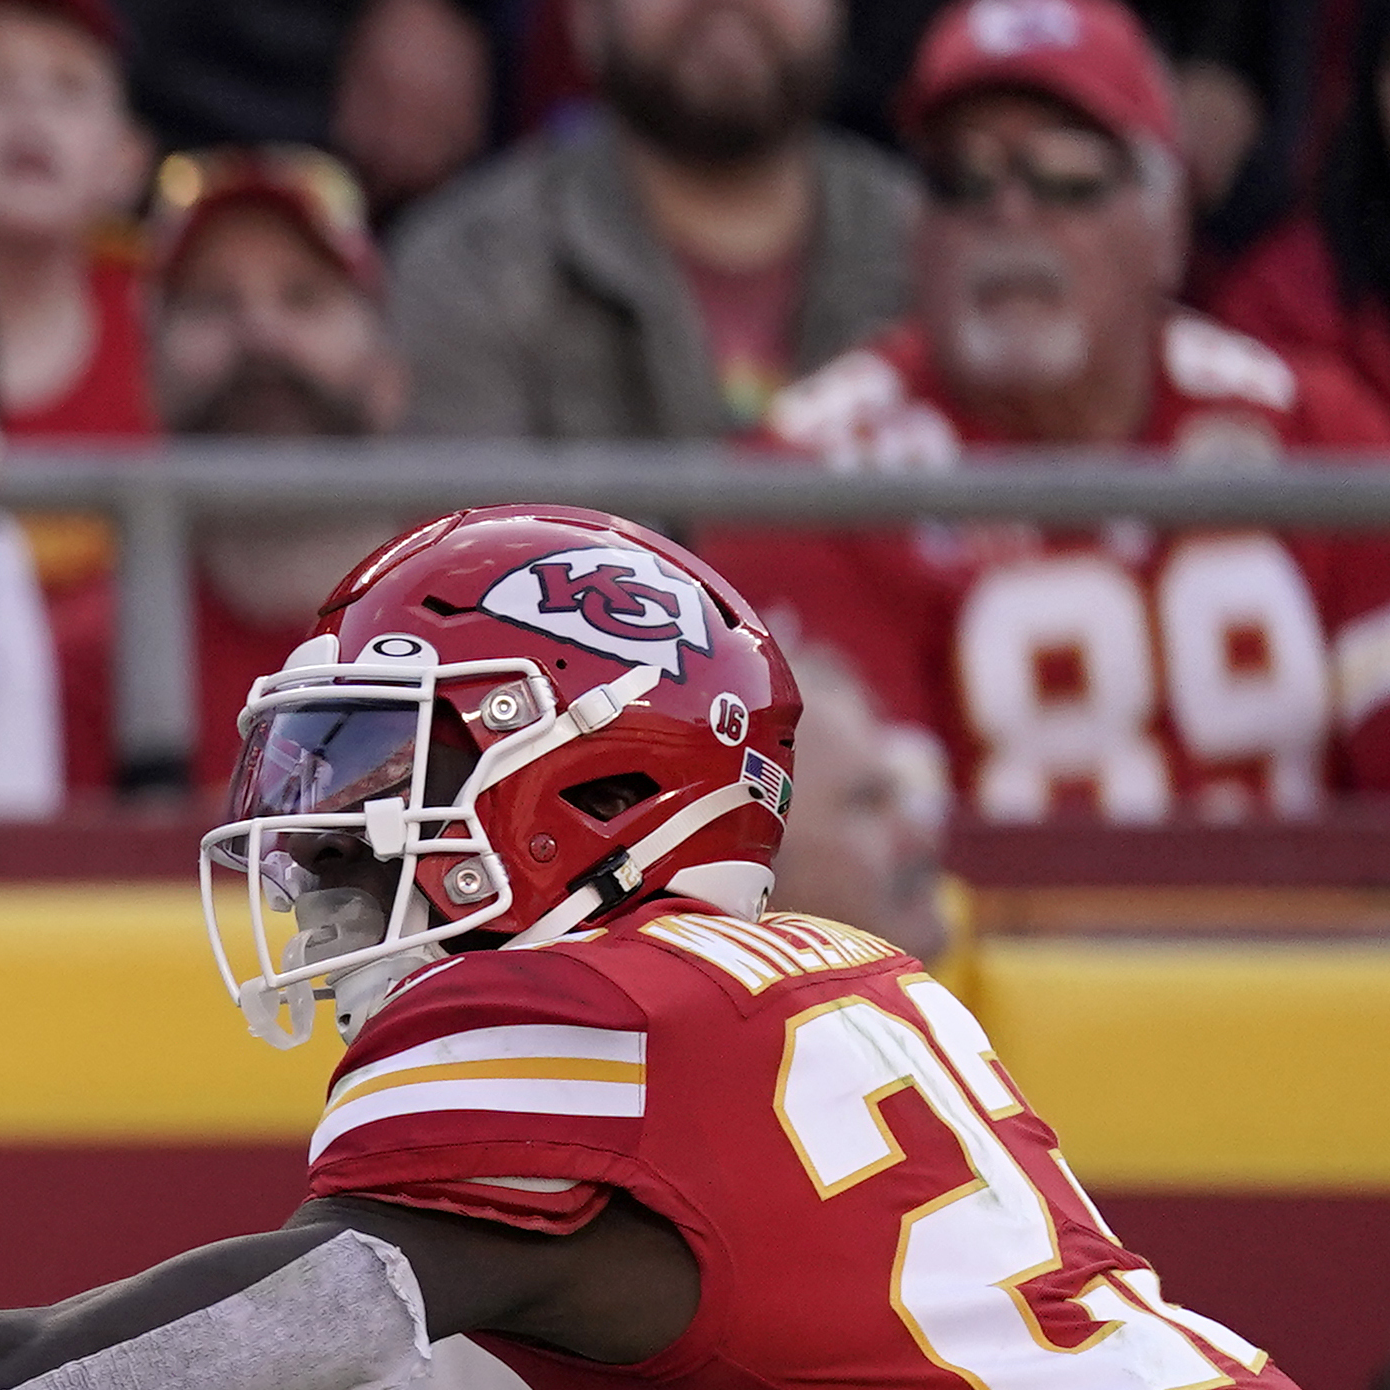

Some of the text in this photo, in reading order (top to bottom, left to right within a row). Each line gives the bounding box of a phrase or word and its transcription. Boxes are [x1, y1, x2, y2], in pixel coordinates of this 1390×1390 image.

[529, 559, 684, 642] KC
[716, 698, 745, 742] 16
[957, 530, 1329, 826] 89
[637, 908, 907, 997] WILLIA
